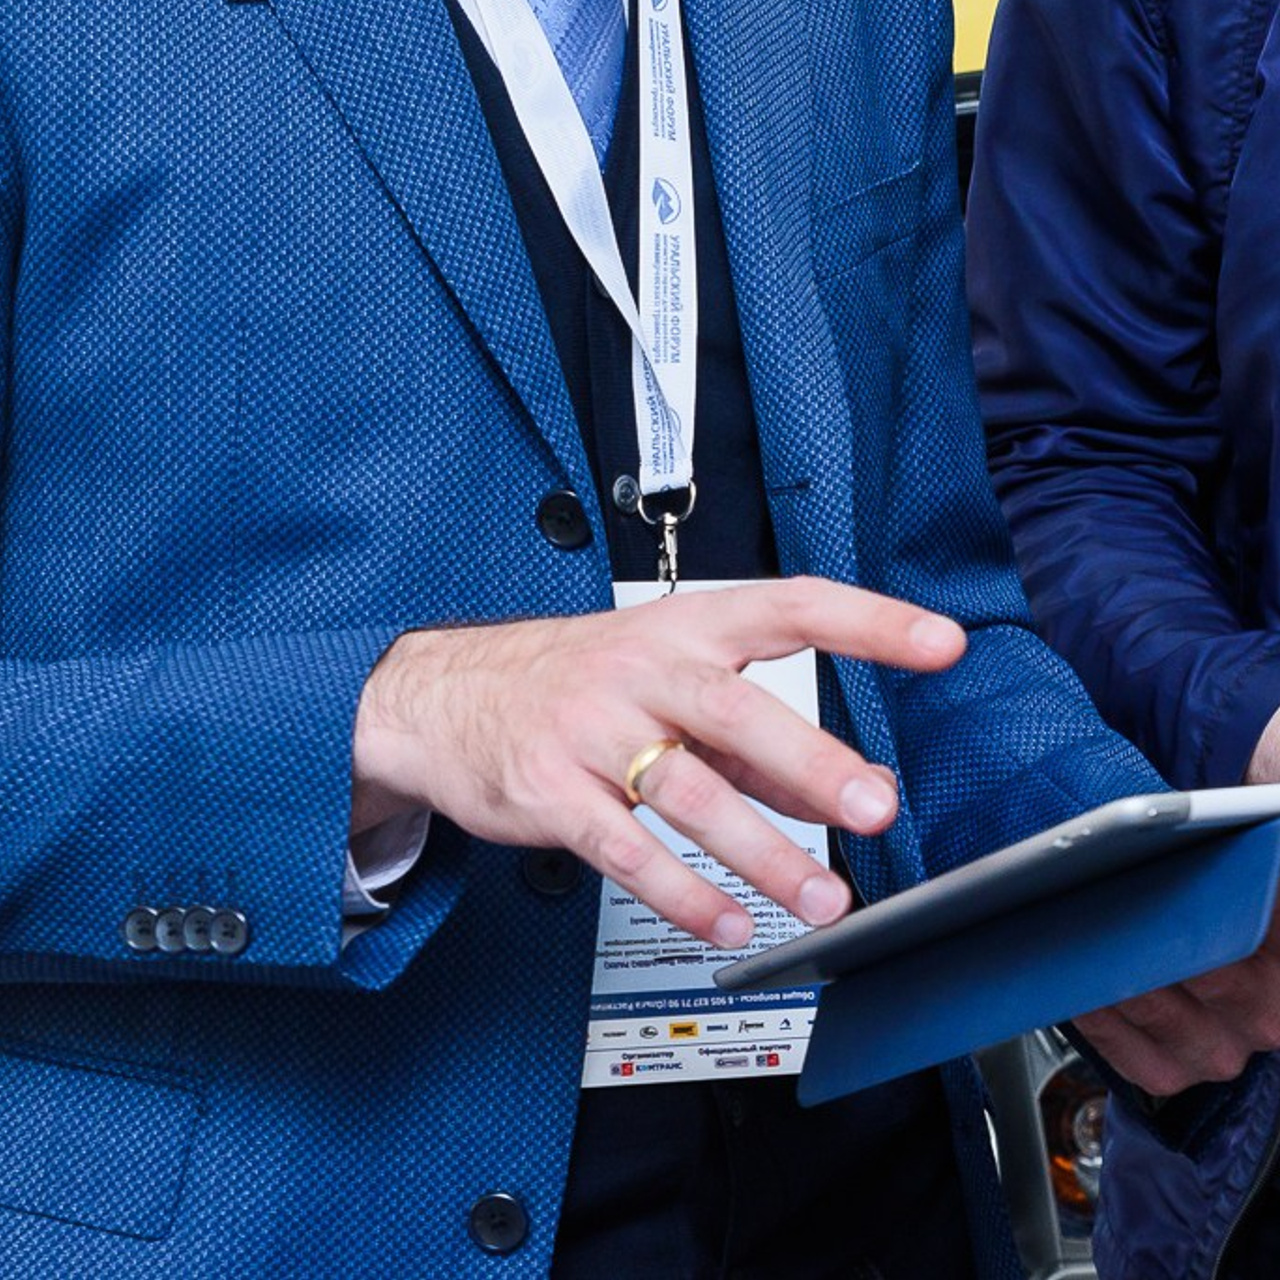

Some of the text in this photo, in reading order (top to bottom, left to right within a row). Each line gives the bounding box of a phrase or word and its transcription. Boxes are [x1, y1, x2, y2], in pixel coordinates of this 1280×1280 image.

[660, 22, 676, 141] УРАЛЬСКИЙ ФОРУМ
[669, 235, 682, 363] УРАЛЬСКИЙ ФОРУМ
[652, 309, 660, 363] транспорта
[740, 992, 780, 1001] вопросы
[781, 991, 814, 1000] Общие
[710, 997, 726, 1005] 905
[698, 1044, 756, 1055] Официальный
[635, 1062, 682, 1071] КОМТРАНС
